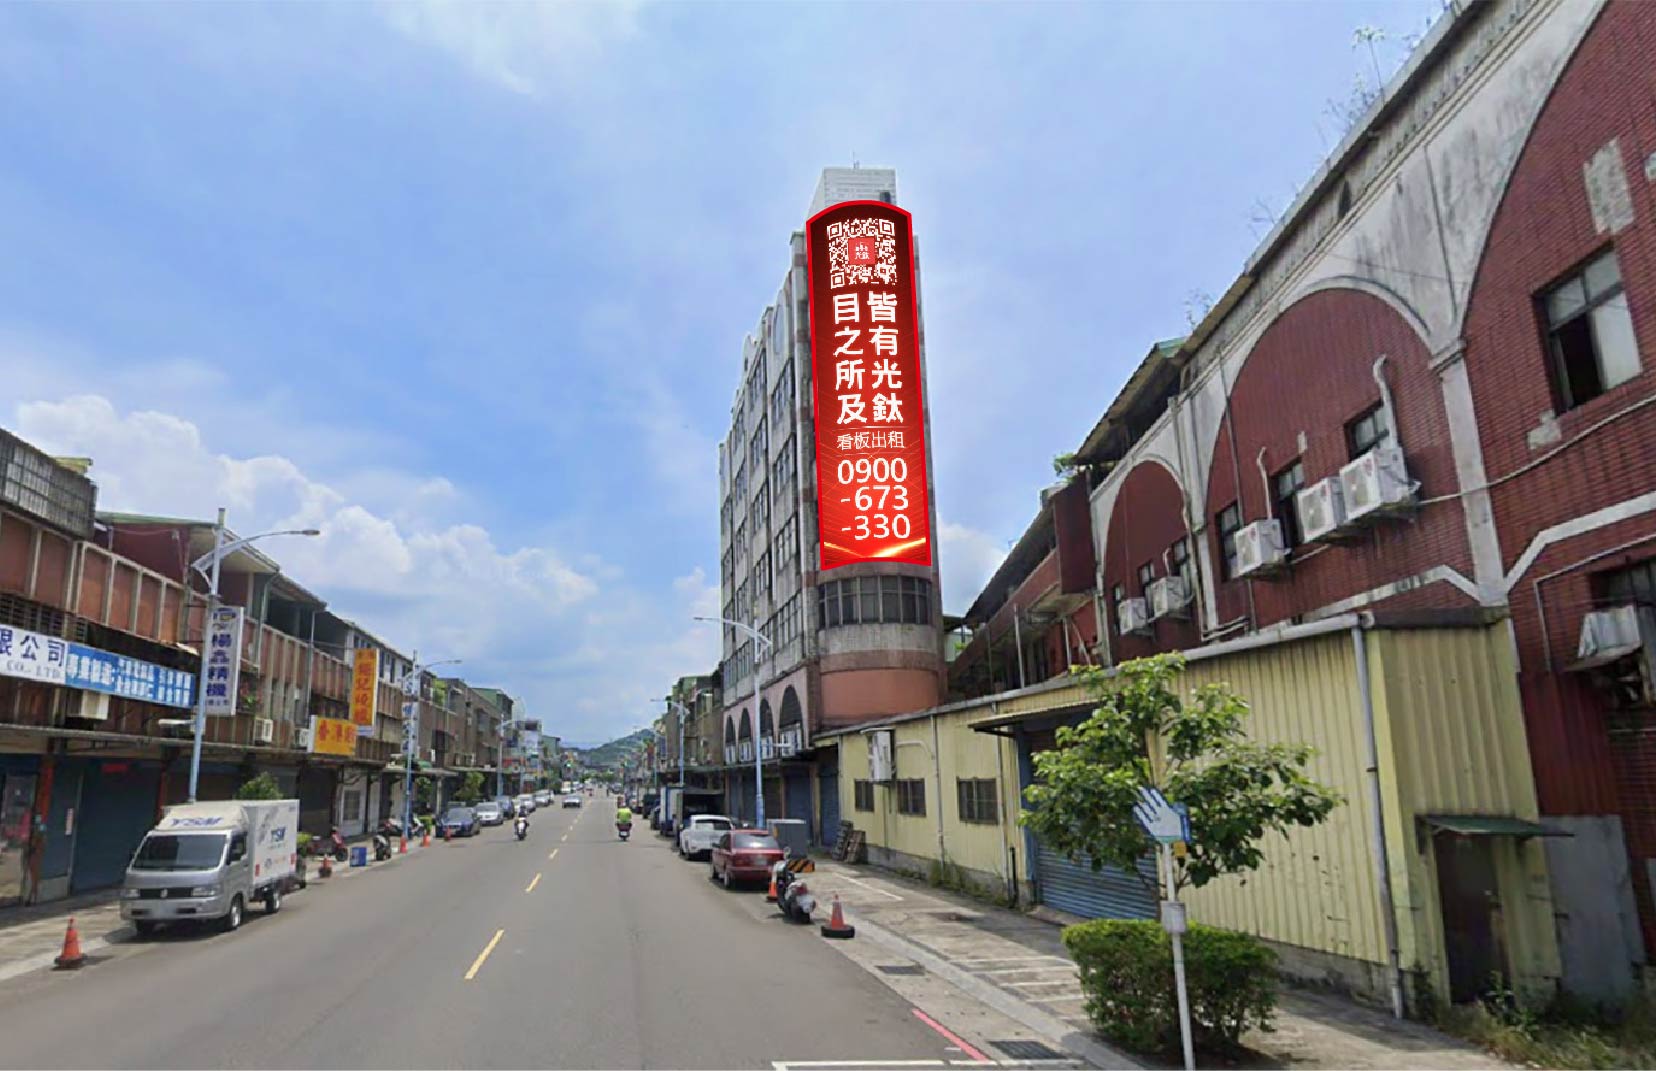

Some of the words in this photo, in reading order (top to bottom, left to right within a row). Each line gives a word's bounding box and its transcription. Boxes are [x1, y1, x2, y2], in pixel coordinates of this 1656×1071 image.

[833, 292, 867, 425] 目之所及
[866, 290, 904, 423] 皆有光鈦
[836, 430, 905, 450] 看板出租
[837, 457, 907, 485] 0900
[840, 484, 909, 511] -673
[841, 513, 911, 540] -330
